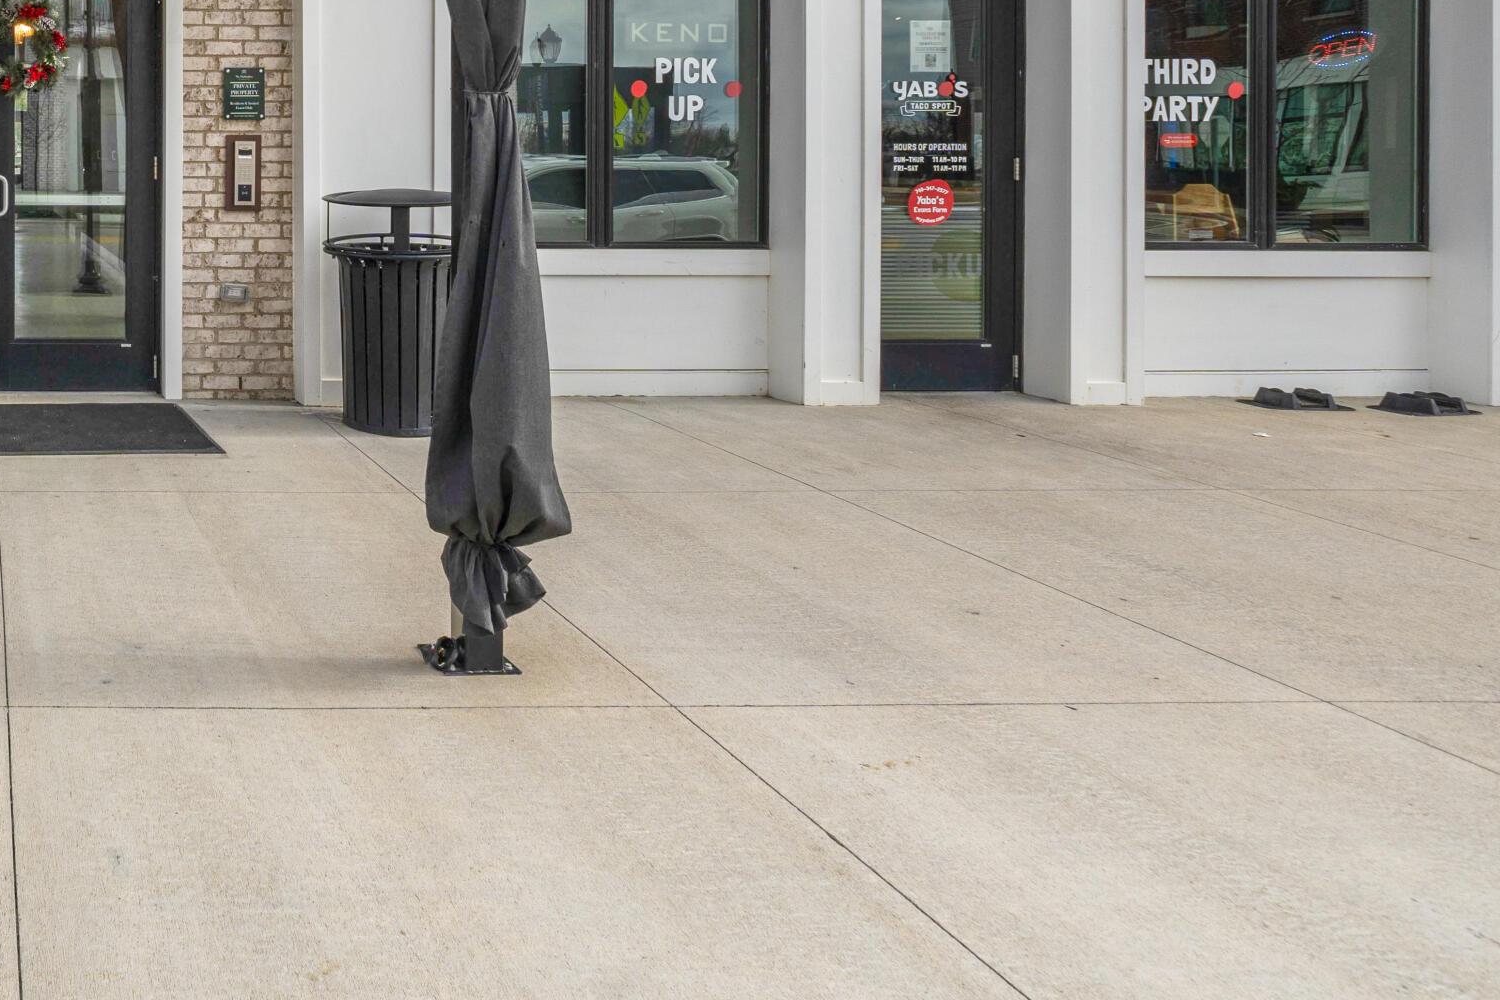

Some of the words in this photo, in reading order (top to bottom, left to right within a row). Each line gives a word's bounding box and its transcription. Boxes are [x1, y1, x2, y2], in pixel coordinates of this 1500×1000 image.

[631, 22, 728, 43] KENO
[1308, 34, 1377, 64] OPEN
[655, 57, 717, 84] PICK
[1143, 58, 1217, 85] THIRD
[668, 94, 704, 122] UP
[910, 102, 930, 110] TACO
[932, 102, 952, 110] SPOT
[1143, 95, 1219, 122] PARTY
[893, 143, 917, 151] HOURS
[918, 143, 927, 151] OF
[928, 143, 967, 151] OPERATION
[916, 195, 945, 205] Yabo's
